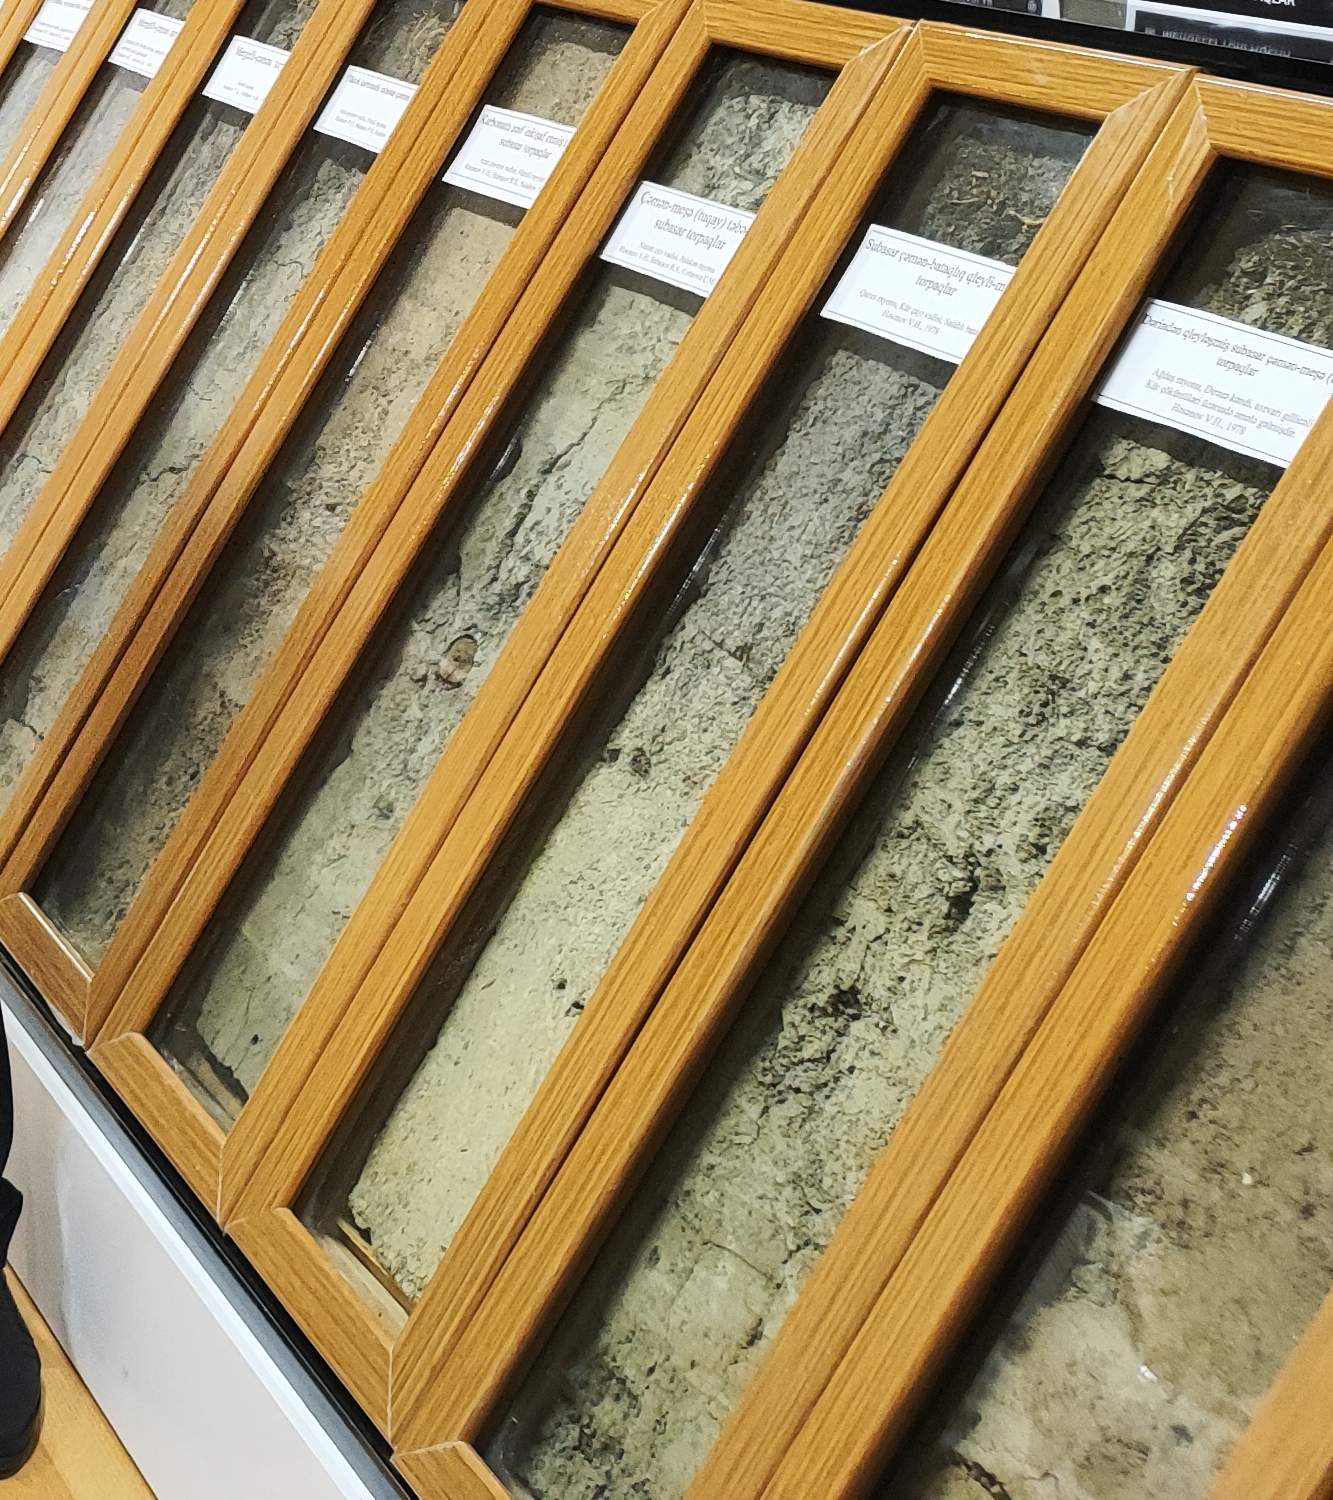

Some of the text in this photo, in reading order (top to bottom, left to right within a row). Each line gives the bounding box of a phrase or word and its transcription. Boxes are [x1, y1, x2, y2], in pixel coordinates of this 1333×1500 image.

[693, 207, 727, 231] (tuqay)
[686, 228, 727, 251] torpaqlar
[865, 238, 899, 258] Subasar
[915, 275, 959, 298] torpaqlar
[1231, 342, 1267, 362] subasar
[1216, 356, 1259, 378] torpaqlar
[1226, 420, 1246, 435] 1978
